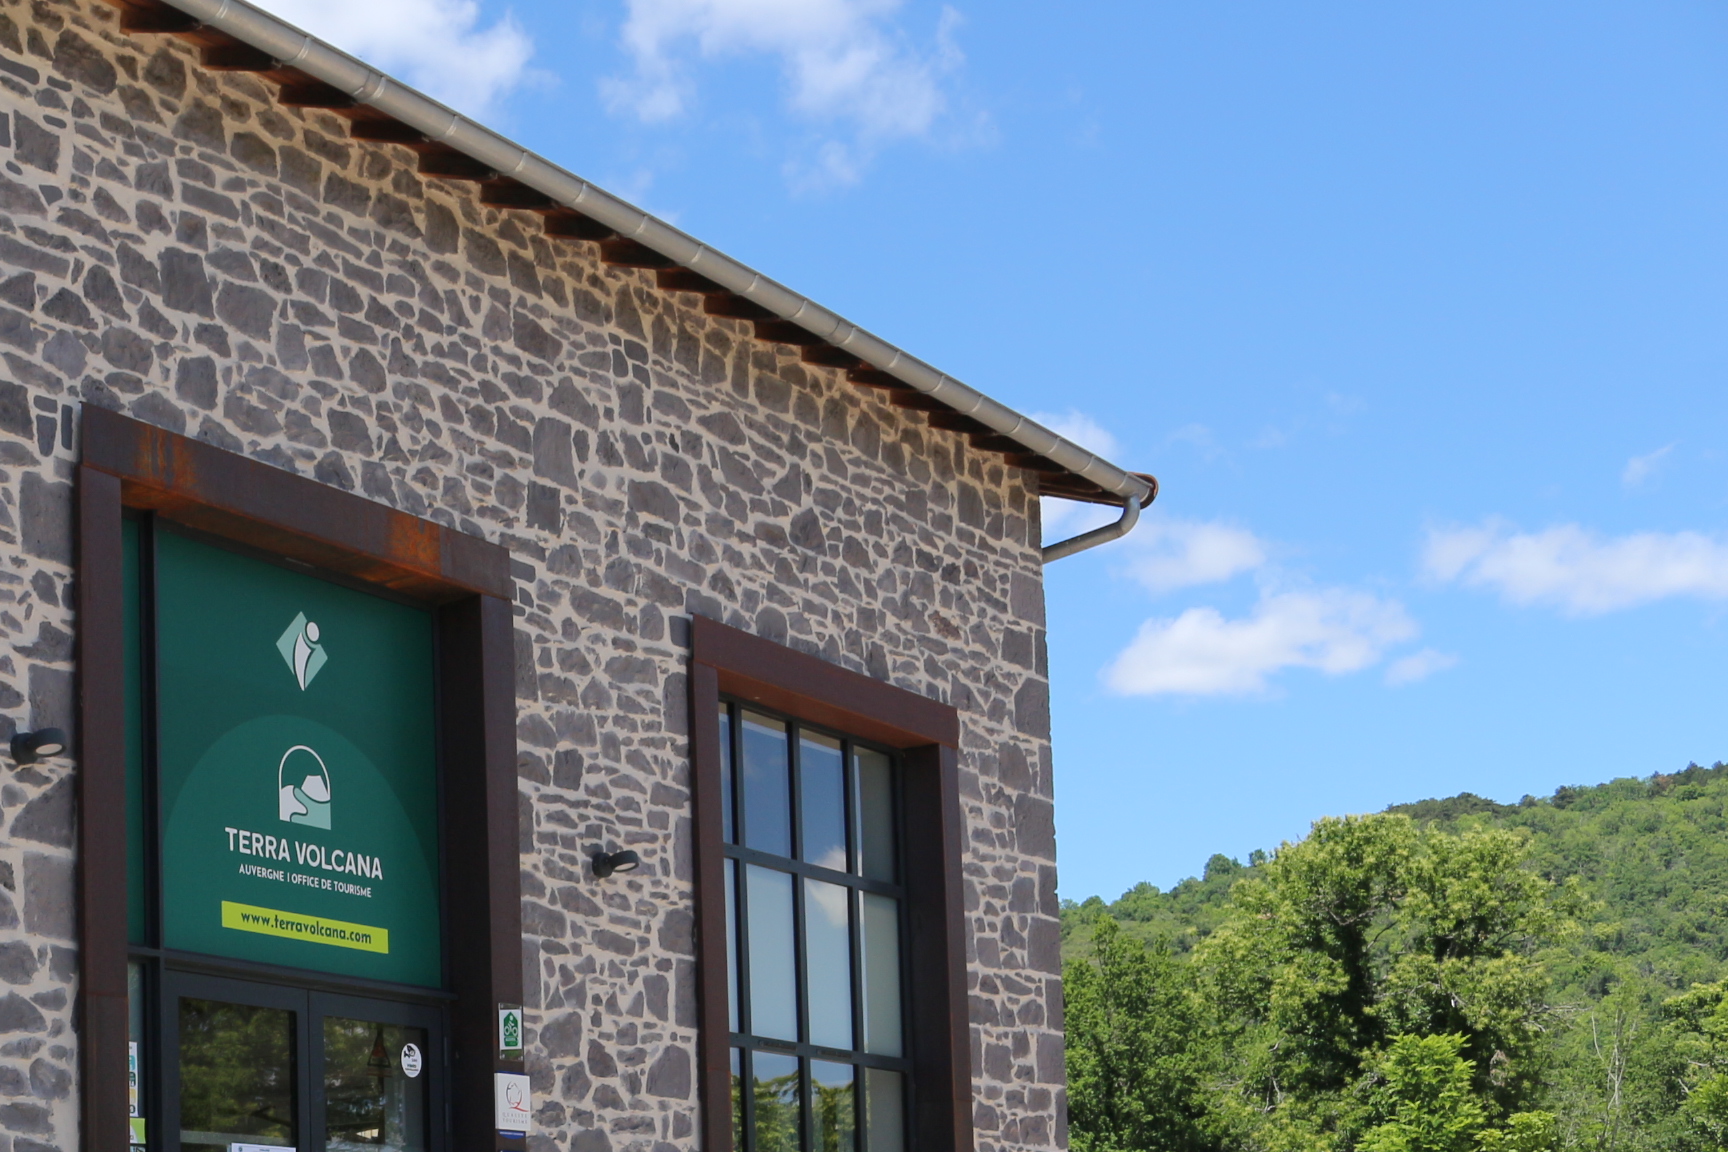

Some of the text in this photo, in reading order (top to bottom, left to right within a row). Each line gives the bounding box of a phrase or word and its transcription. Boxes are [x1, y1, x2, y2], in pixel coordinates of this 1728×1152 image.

[224, 826, 384, 881] TERRA VOLCANA
[238, 863, 285, 882] AUVERGNE
[291, 873, 320, 889] OFFICE
[321, 878, 333, 891] DE
[333, 881, 373, 899] TOURISME
[240, 911, 373, 945] www.terravolcana.com
